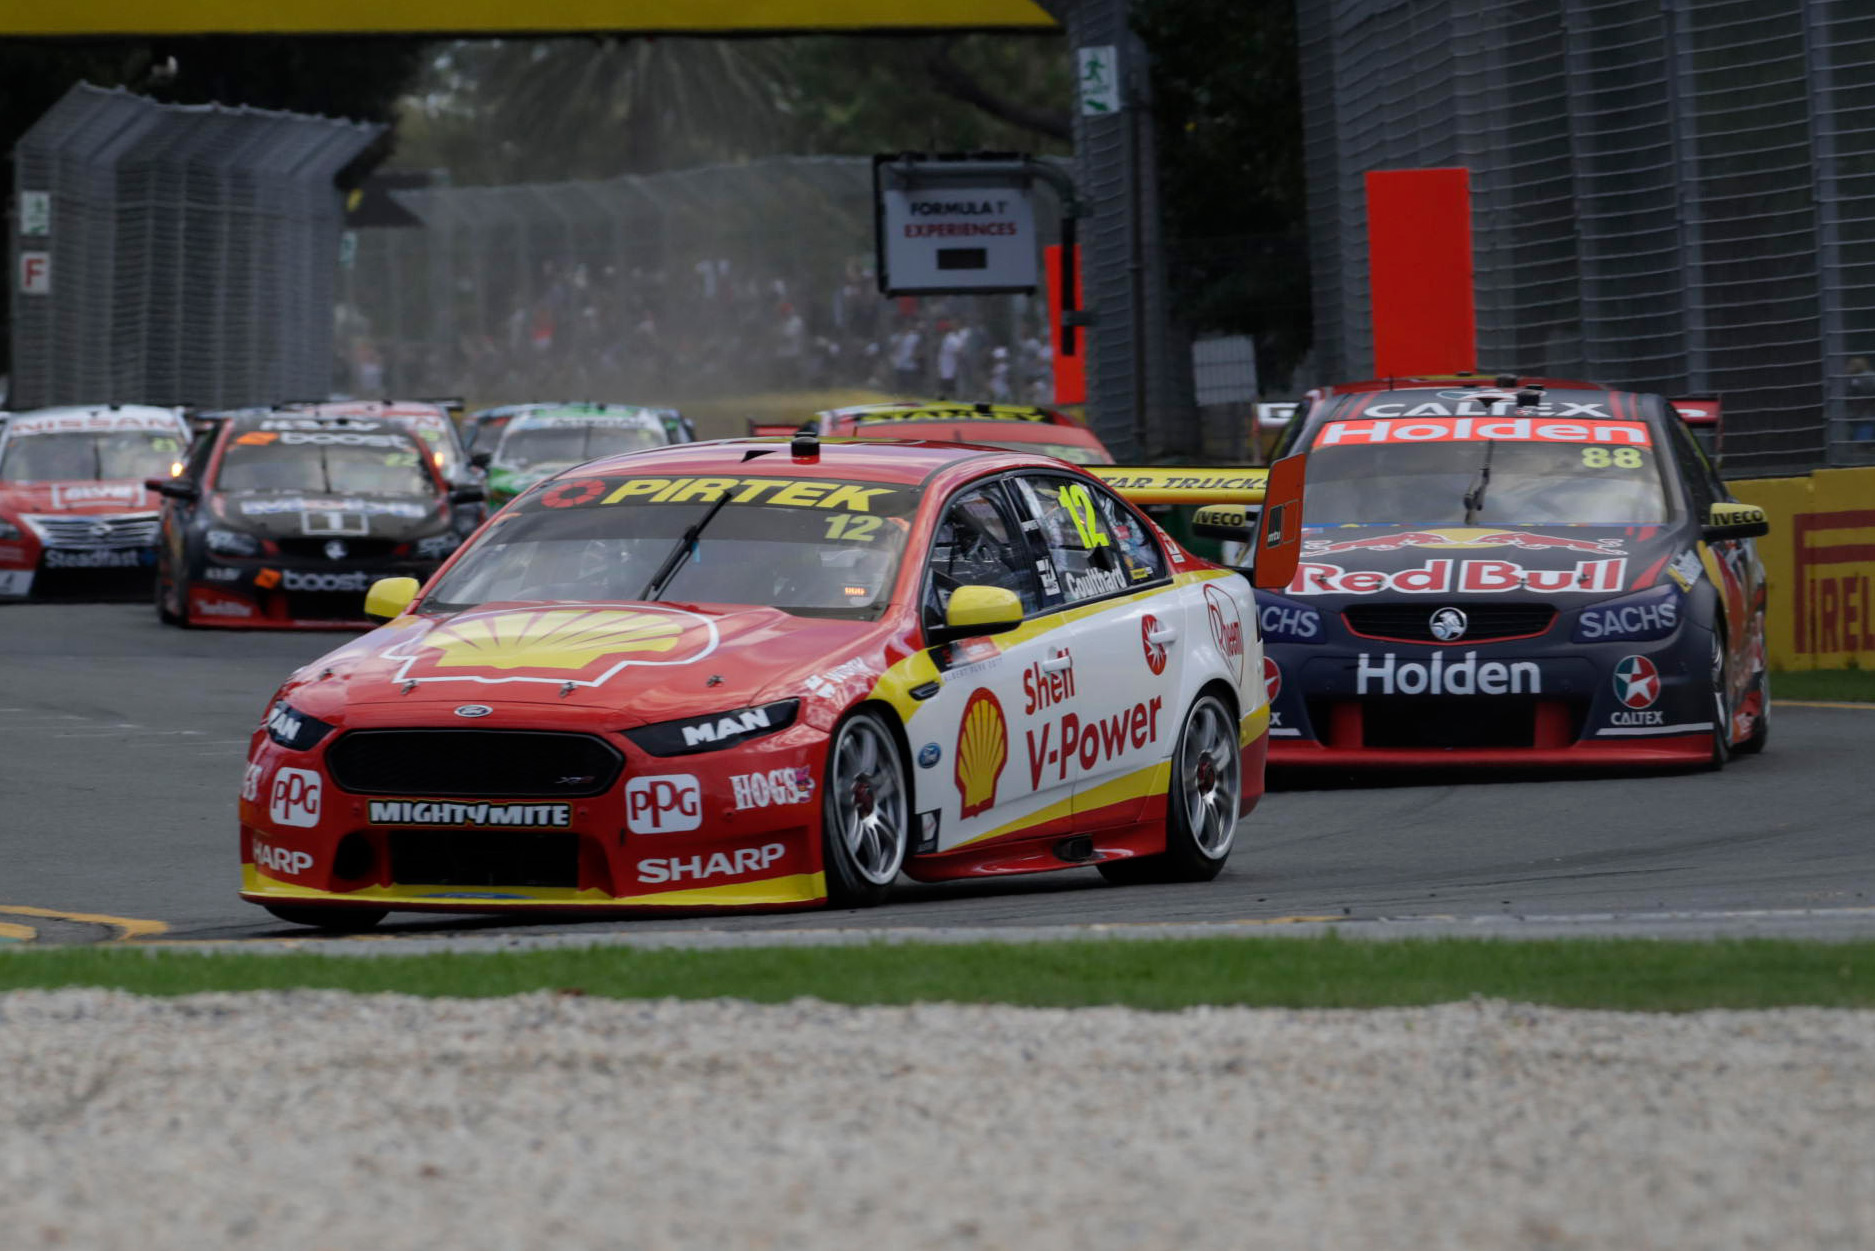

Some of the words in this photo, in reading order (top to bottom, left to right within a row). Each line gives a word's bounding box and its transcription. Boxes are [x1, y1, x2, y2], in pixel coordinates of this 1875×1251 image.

[910, 201, 993, 215] FORMULA
[904, 222, 1018, 237] EXPERIENCES
[25, 258, 46, 287] F
[12, 417, 178, 432] NISSAN
[280, 431, 409, 450] boost
[1322, 418, 1647, 444] Holden
[1581, 447, 1643, 469] 88
[600, 478, 900, 512] PIRTEK
[824, 513, 884, 542] 12
[1058, 484, 1110, 549] 12
[1713, 509, 1764, 526] IVECO
[283, 569, 368, 591] boost
[1066, 557, 1128, 600] Coulthard
[1286, 560, 1454, 594] Red
[1458, 558, 1627, 593] Bull
[1579, 603, 1677, 638] SACHS
[1023, 647, 1075, 715] Shell
[1357, 650, 1542, 695] Holden
[682, 708, 771, 746] MAN
[1610, 711, 1664, 725] CALTEX
[1026, 694, 1162, 791] V-Power
[273, 773, 319, 820] PPG
[629, 780, 699, 828] PPG
[730, 766, 799, 811] HOGS
[636, 843, 786, 884] SHARP
